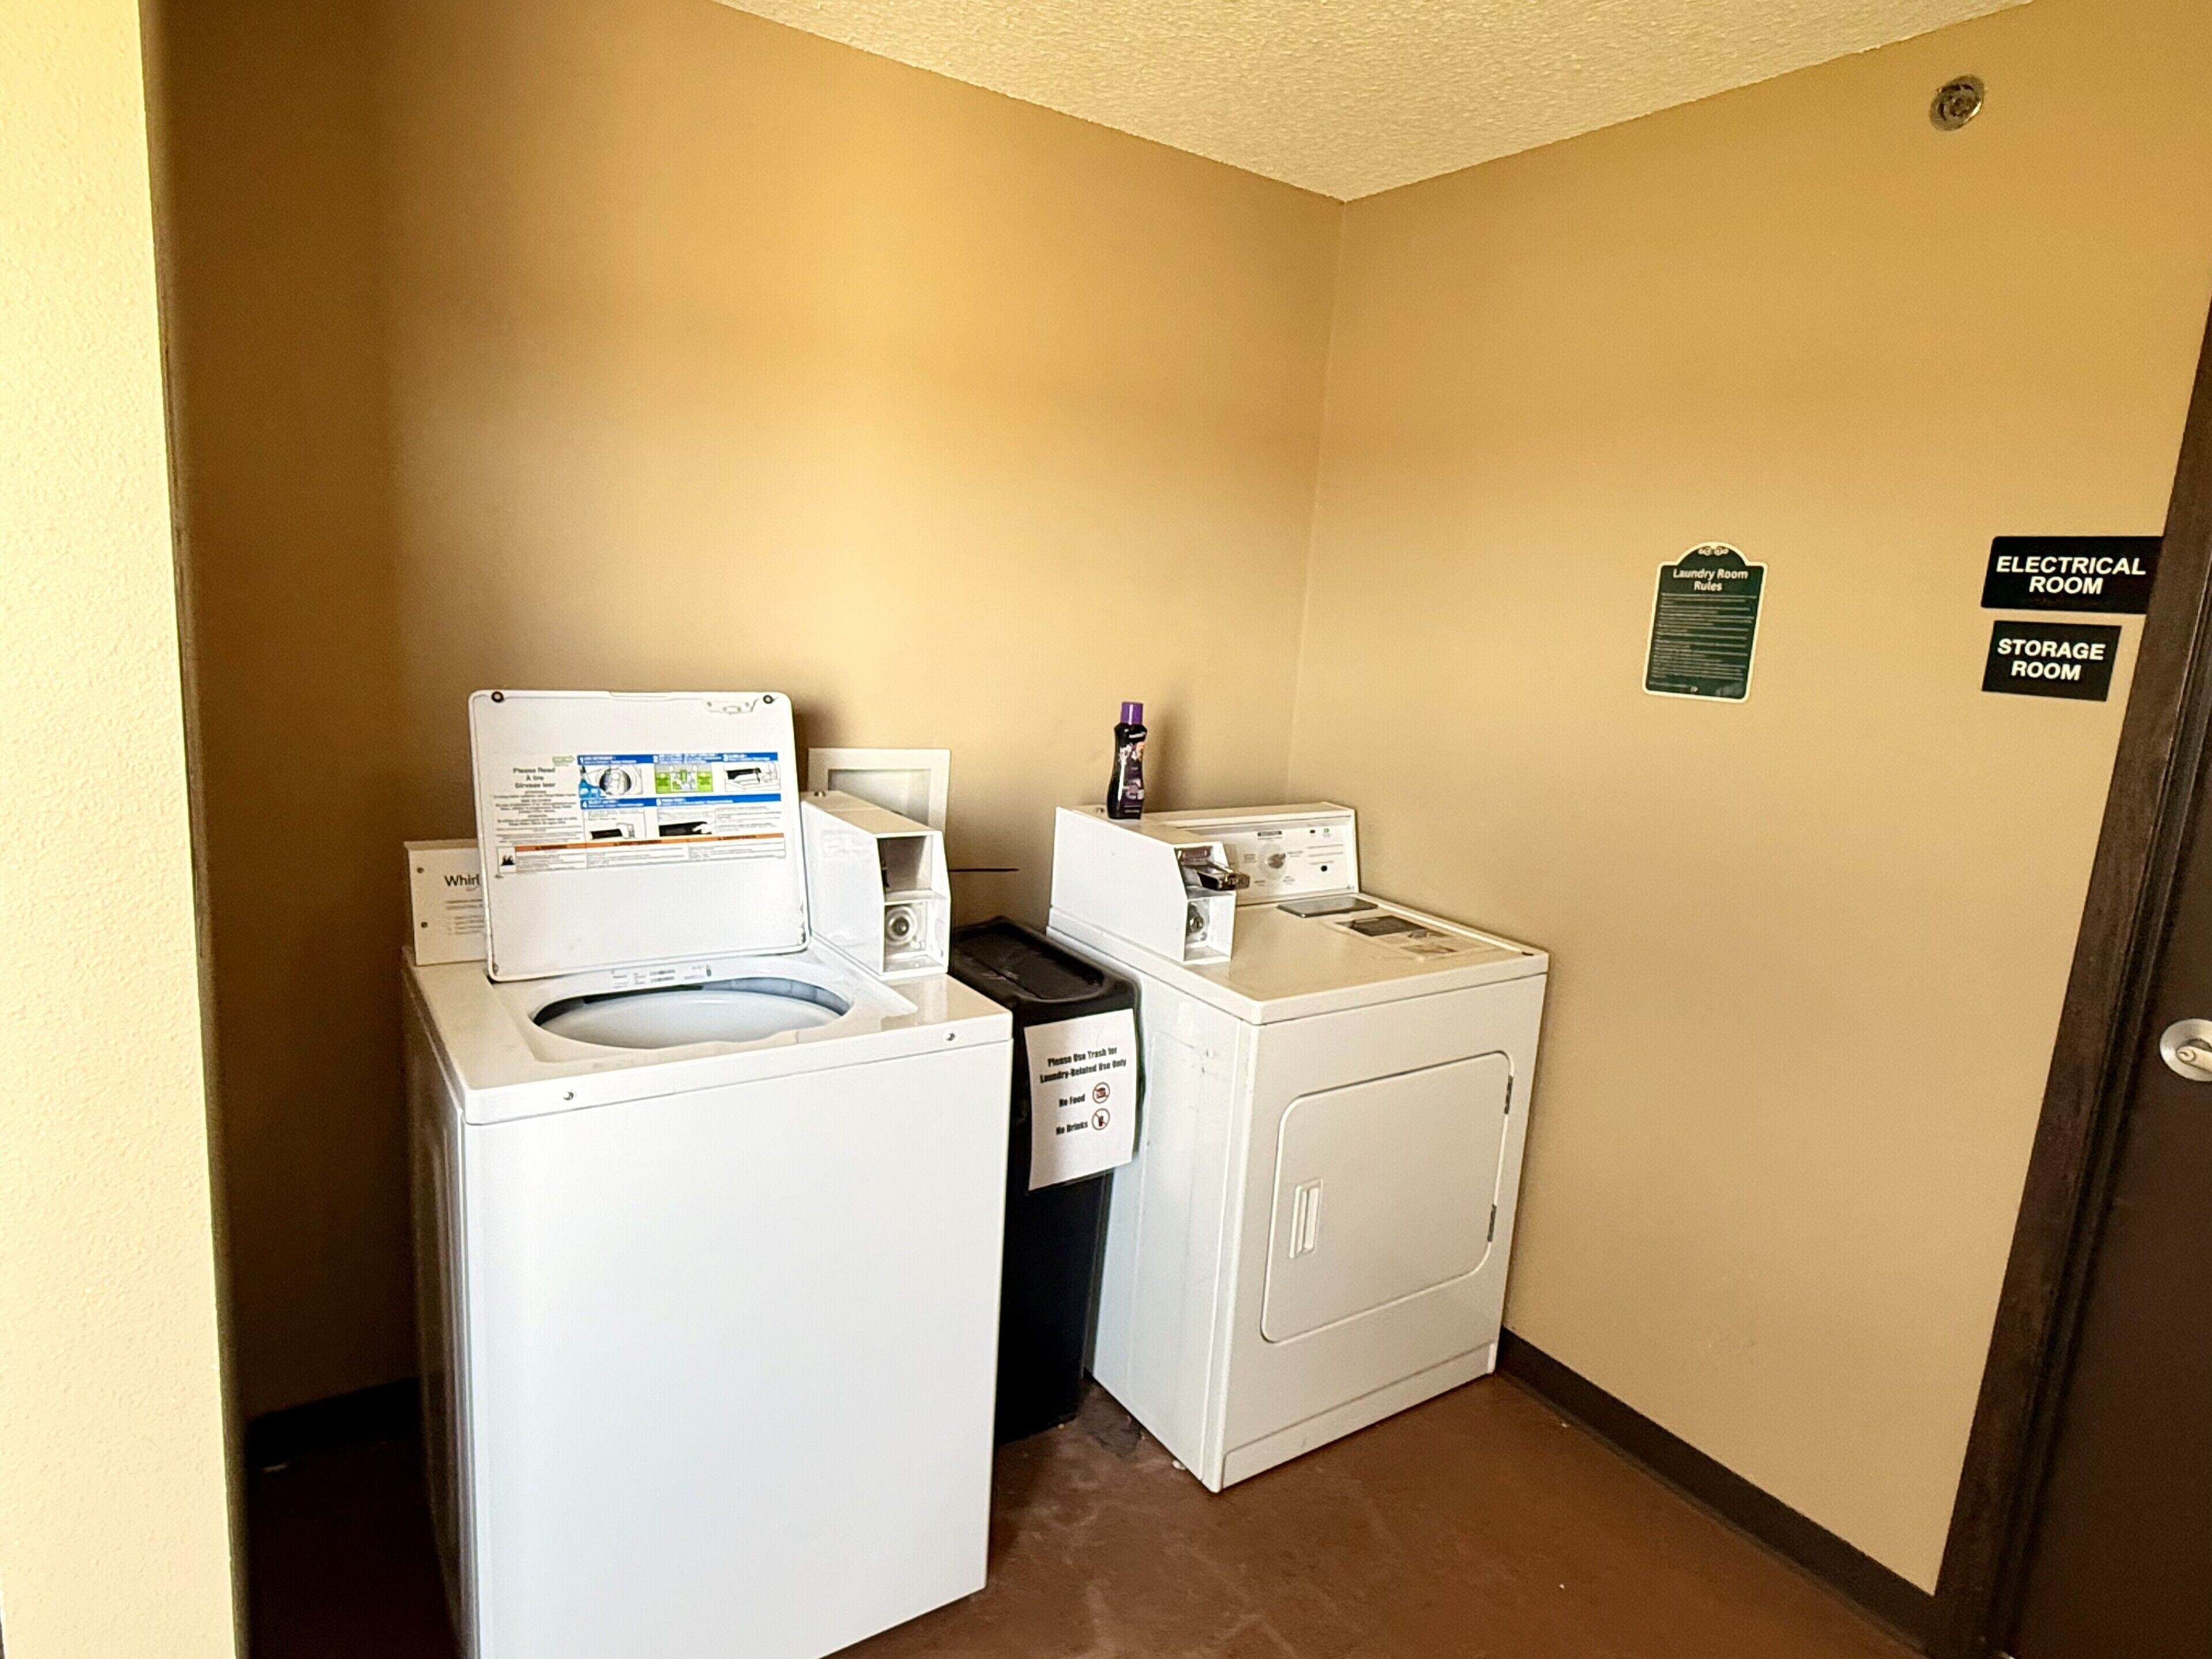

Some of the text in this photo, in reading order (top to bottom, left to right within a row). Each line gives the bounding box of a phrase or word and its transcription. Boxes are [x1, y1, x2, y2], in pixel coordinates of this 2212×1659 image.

[1673, 568, 1748, 581] Laundry Room
[1996, 555, 2146, 575] ELECTRICAL
[1694, 581, 1722, 591] Rules
[2029, 576, 2103, 594] ROOM
[1997, 638, 2106, 660] STORAGE
[2011, 661, 2081, 681] ROOM
[1047, 1047, 1117, 1067] Please Use Trash for
[1040, 1059, 1127, 1084] Laundry-Related Use Only
[1059, 1093, 1085, 1108] No Food
[1056, 1121, 1088, 1135] No Drinks
